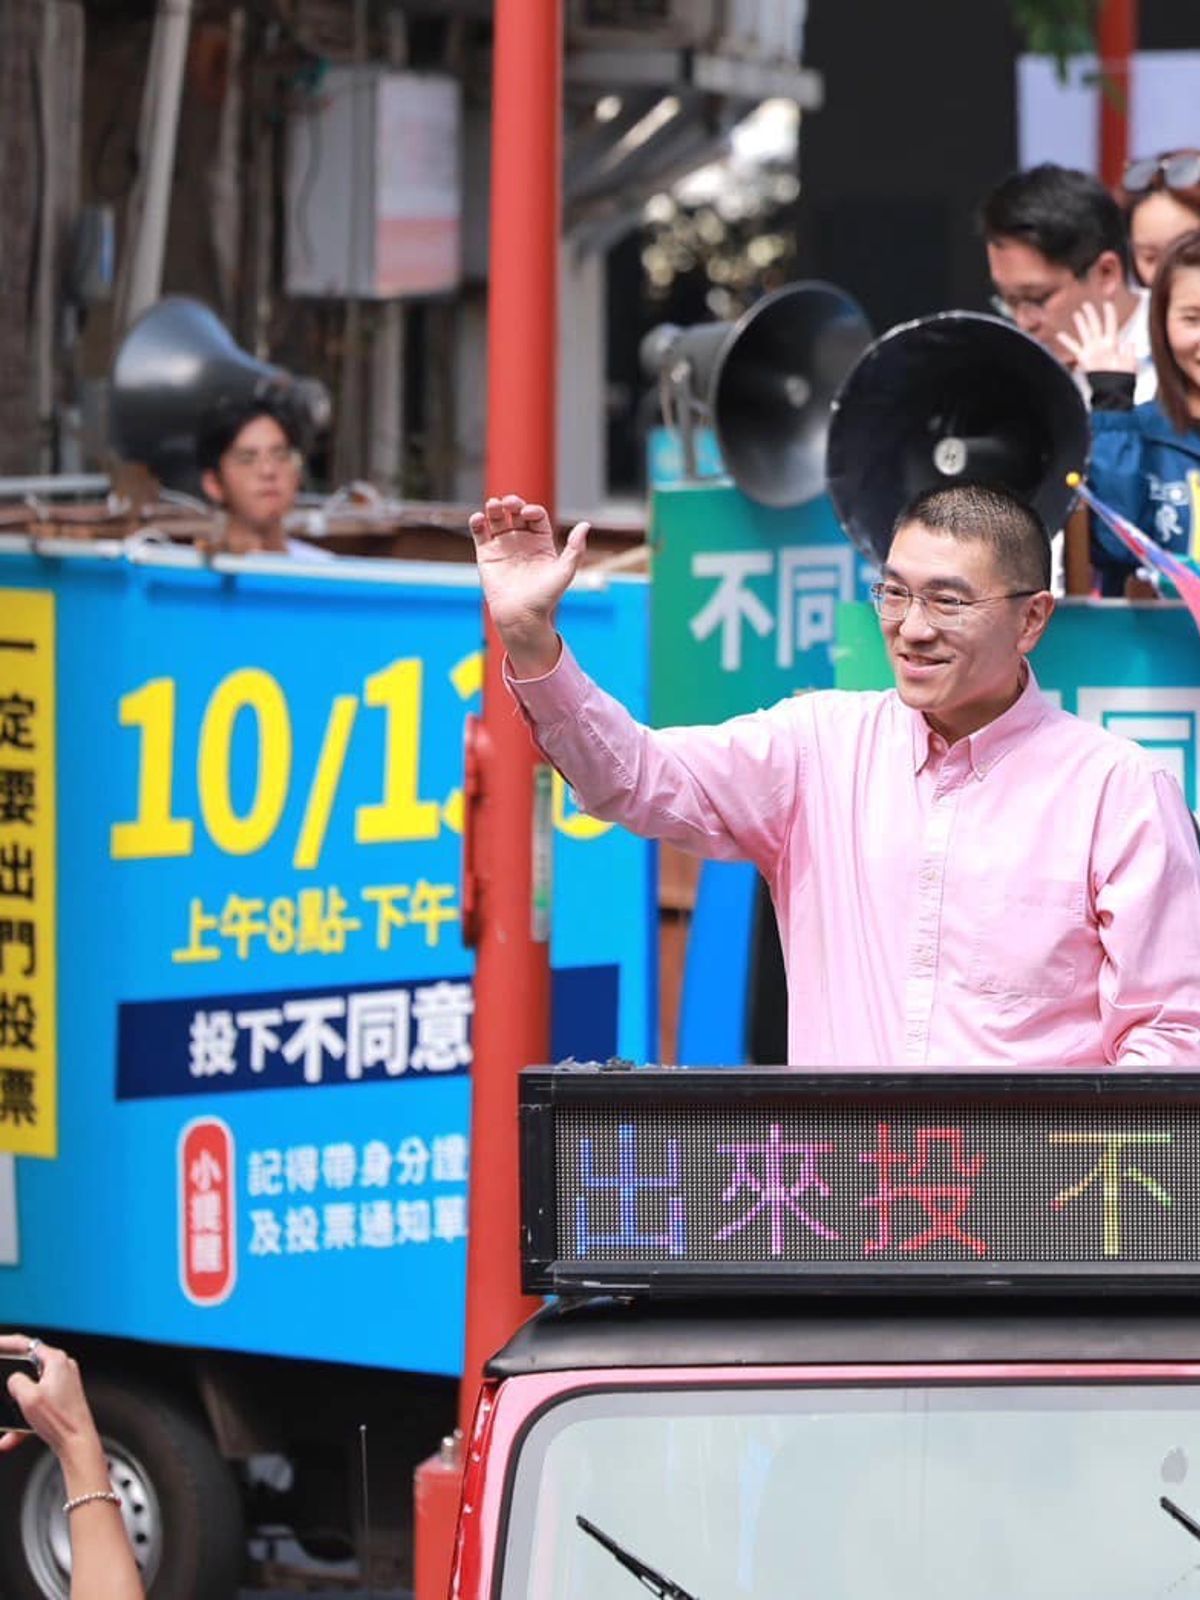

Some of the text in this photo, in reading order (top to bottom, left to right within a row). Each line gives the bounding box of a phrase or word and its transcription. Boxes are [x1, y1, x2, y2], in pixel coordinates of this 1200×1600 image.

[690, 545, 882, 672] 不同
[0, 638, 37, 1127] 一定要出門投票
[189, 982, 475, 1083] 投下不同意
[575, 1123, 987, 1256] 出來投
